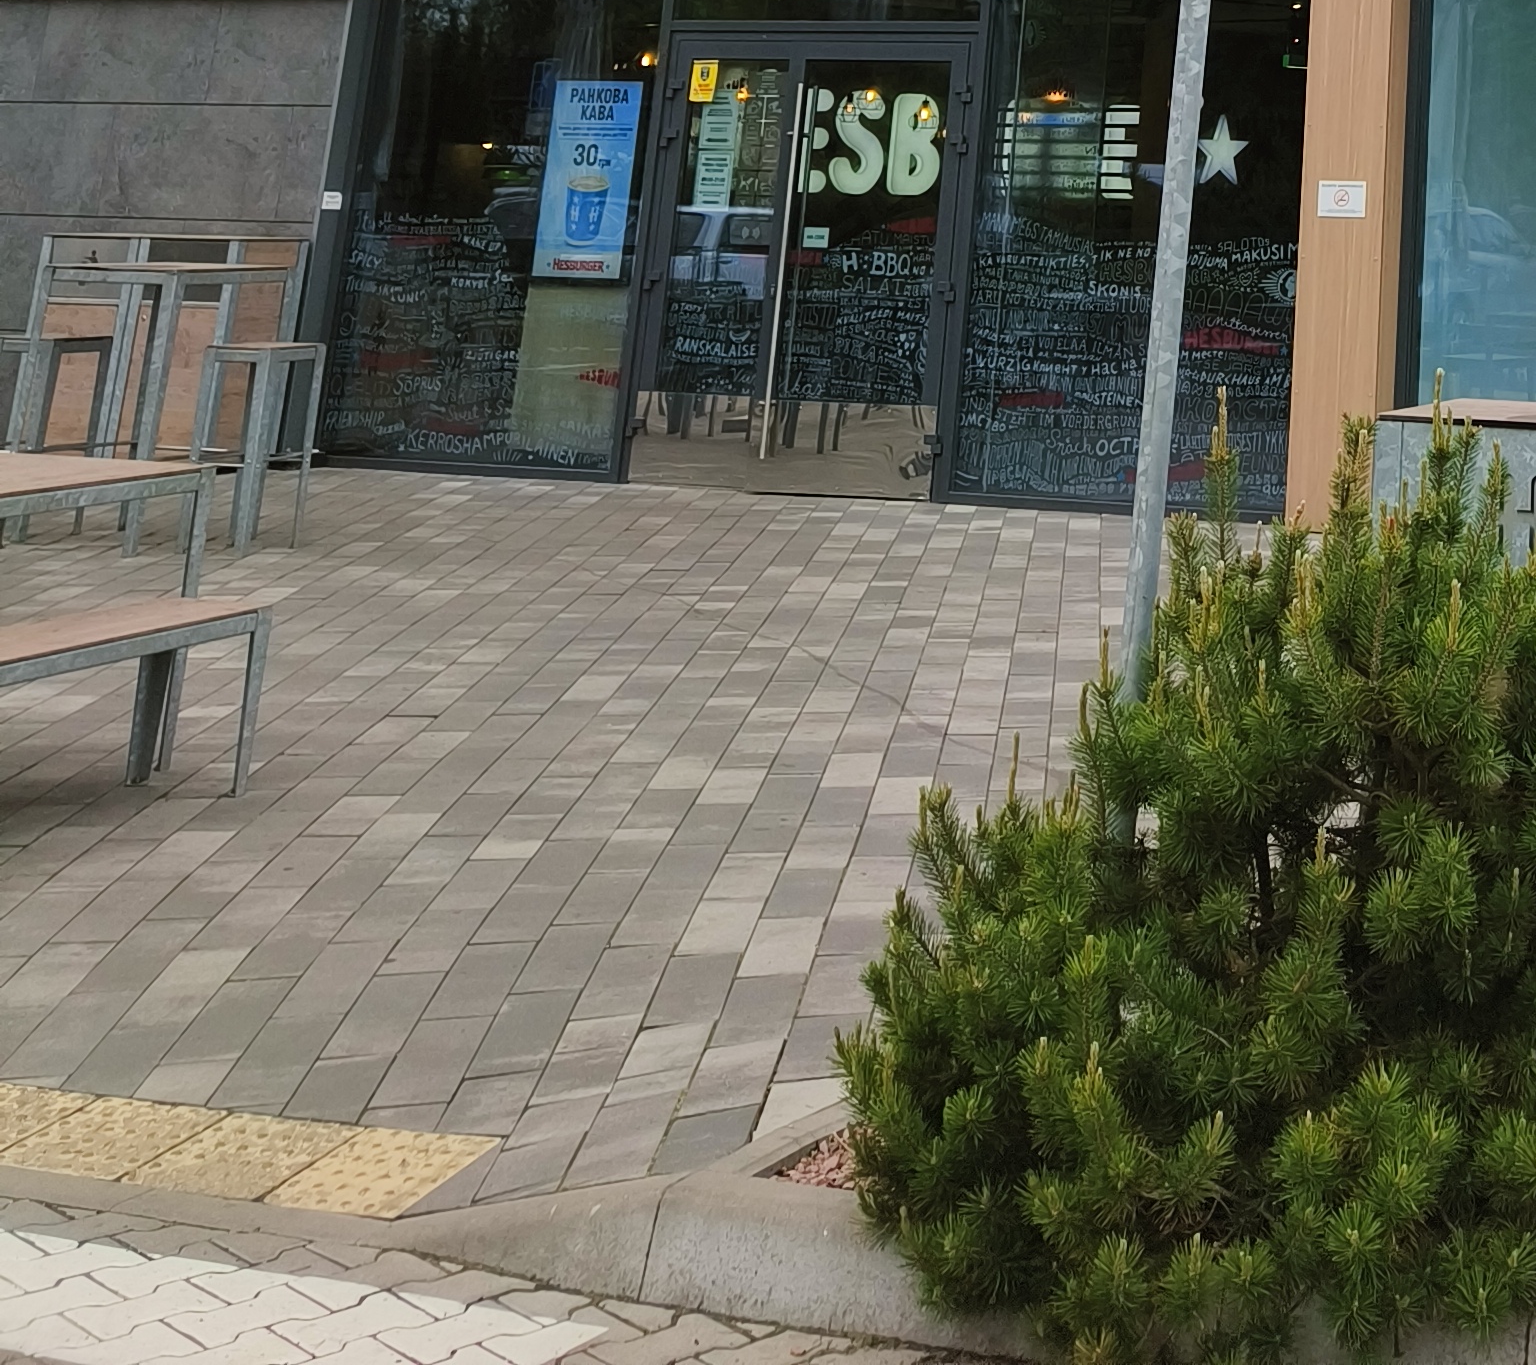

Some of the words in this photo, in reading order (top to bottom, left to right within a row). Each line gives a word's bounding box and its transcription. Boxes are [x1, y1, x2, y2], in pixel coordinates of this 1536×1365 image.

[570, 87, 630, 105] РАНКОВА
[580, 104, 615, 122] КАВА
[573, 143, 599, 167] 30
[869, 250, 913, 277] BBQ
[1231, 243, 1285, 263] MAKUSI
[841, 274, 905, 296] SALAT
[1088, 280, 1142, 298] SKONIS
[675, 335, 758, 358] RANSKALAISE
[407, 426, 578, 467] KERROSHAMPURILAINEN
